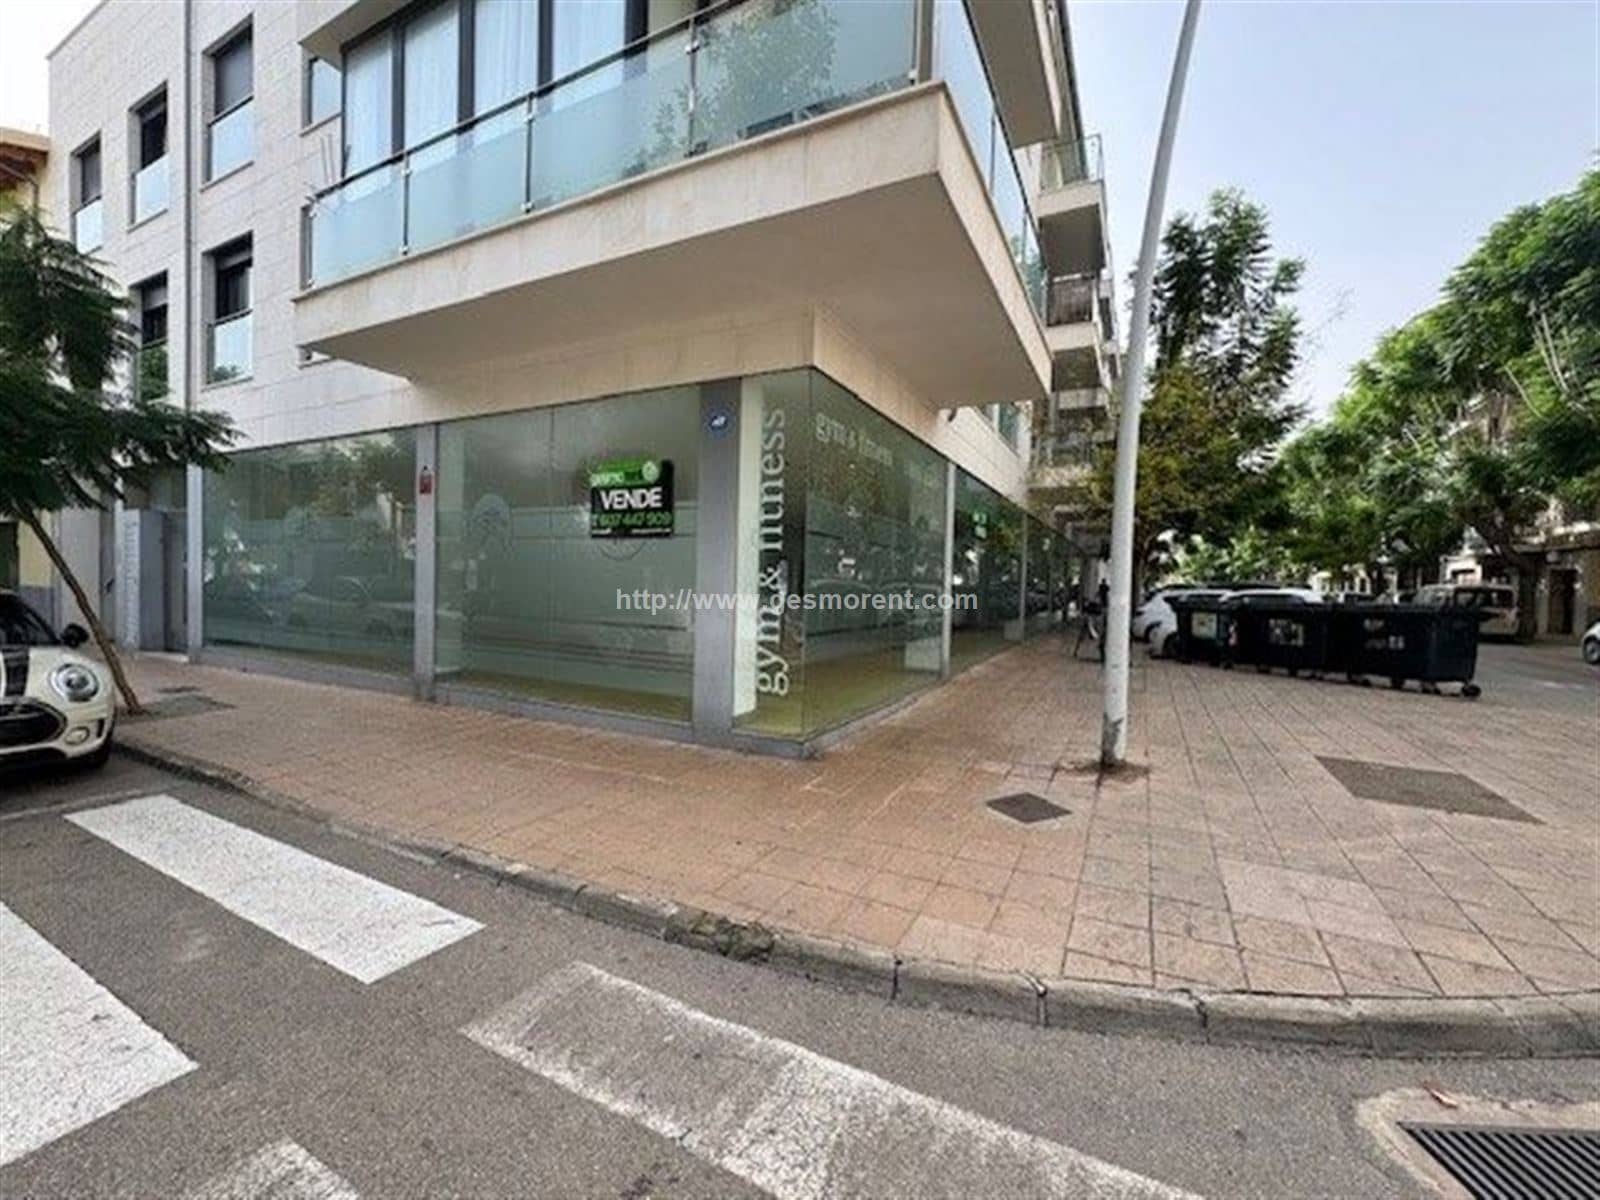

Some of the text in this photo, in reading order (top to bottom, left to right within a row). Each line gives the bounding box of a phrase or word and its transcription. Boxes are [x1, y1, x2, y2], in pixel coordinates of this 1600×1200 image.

[600, 487, 663, 510] VENDE
[758, 565, 782, 590] &
[754, 605, 789, 696] gym
